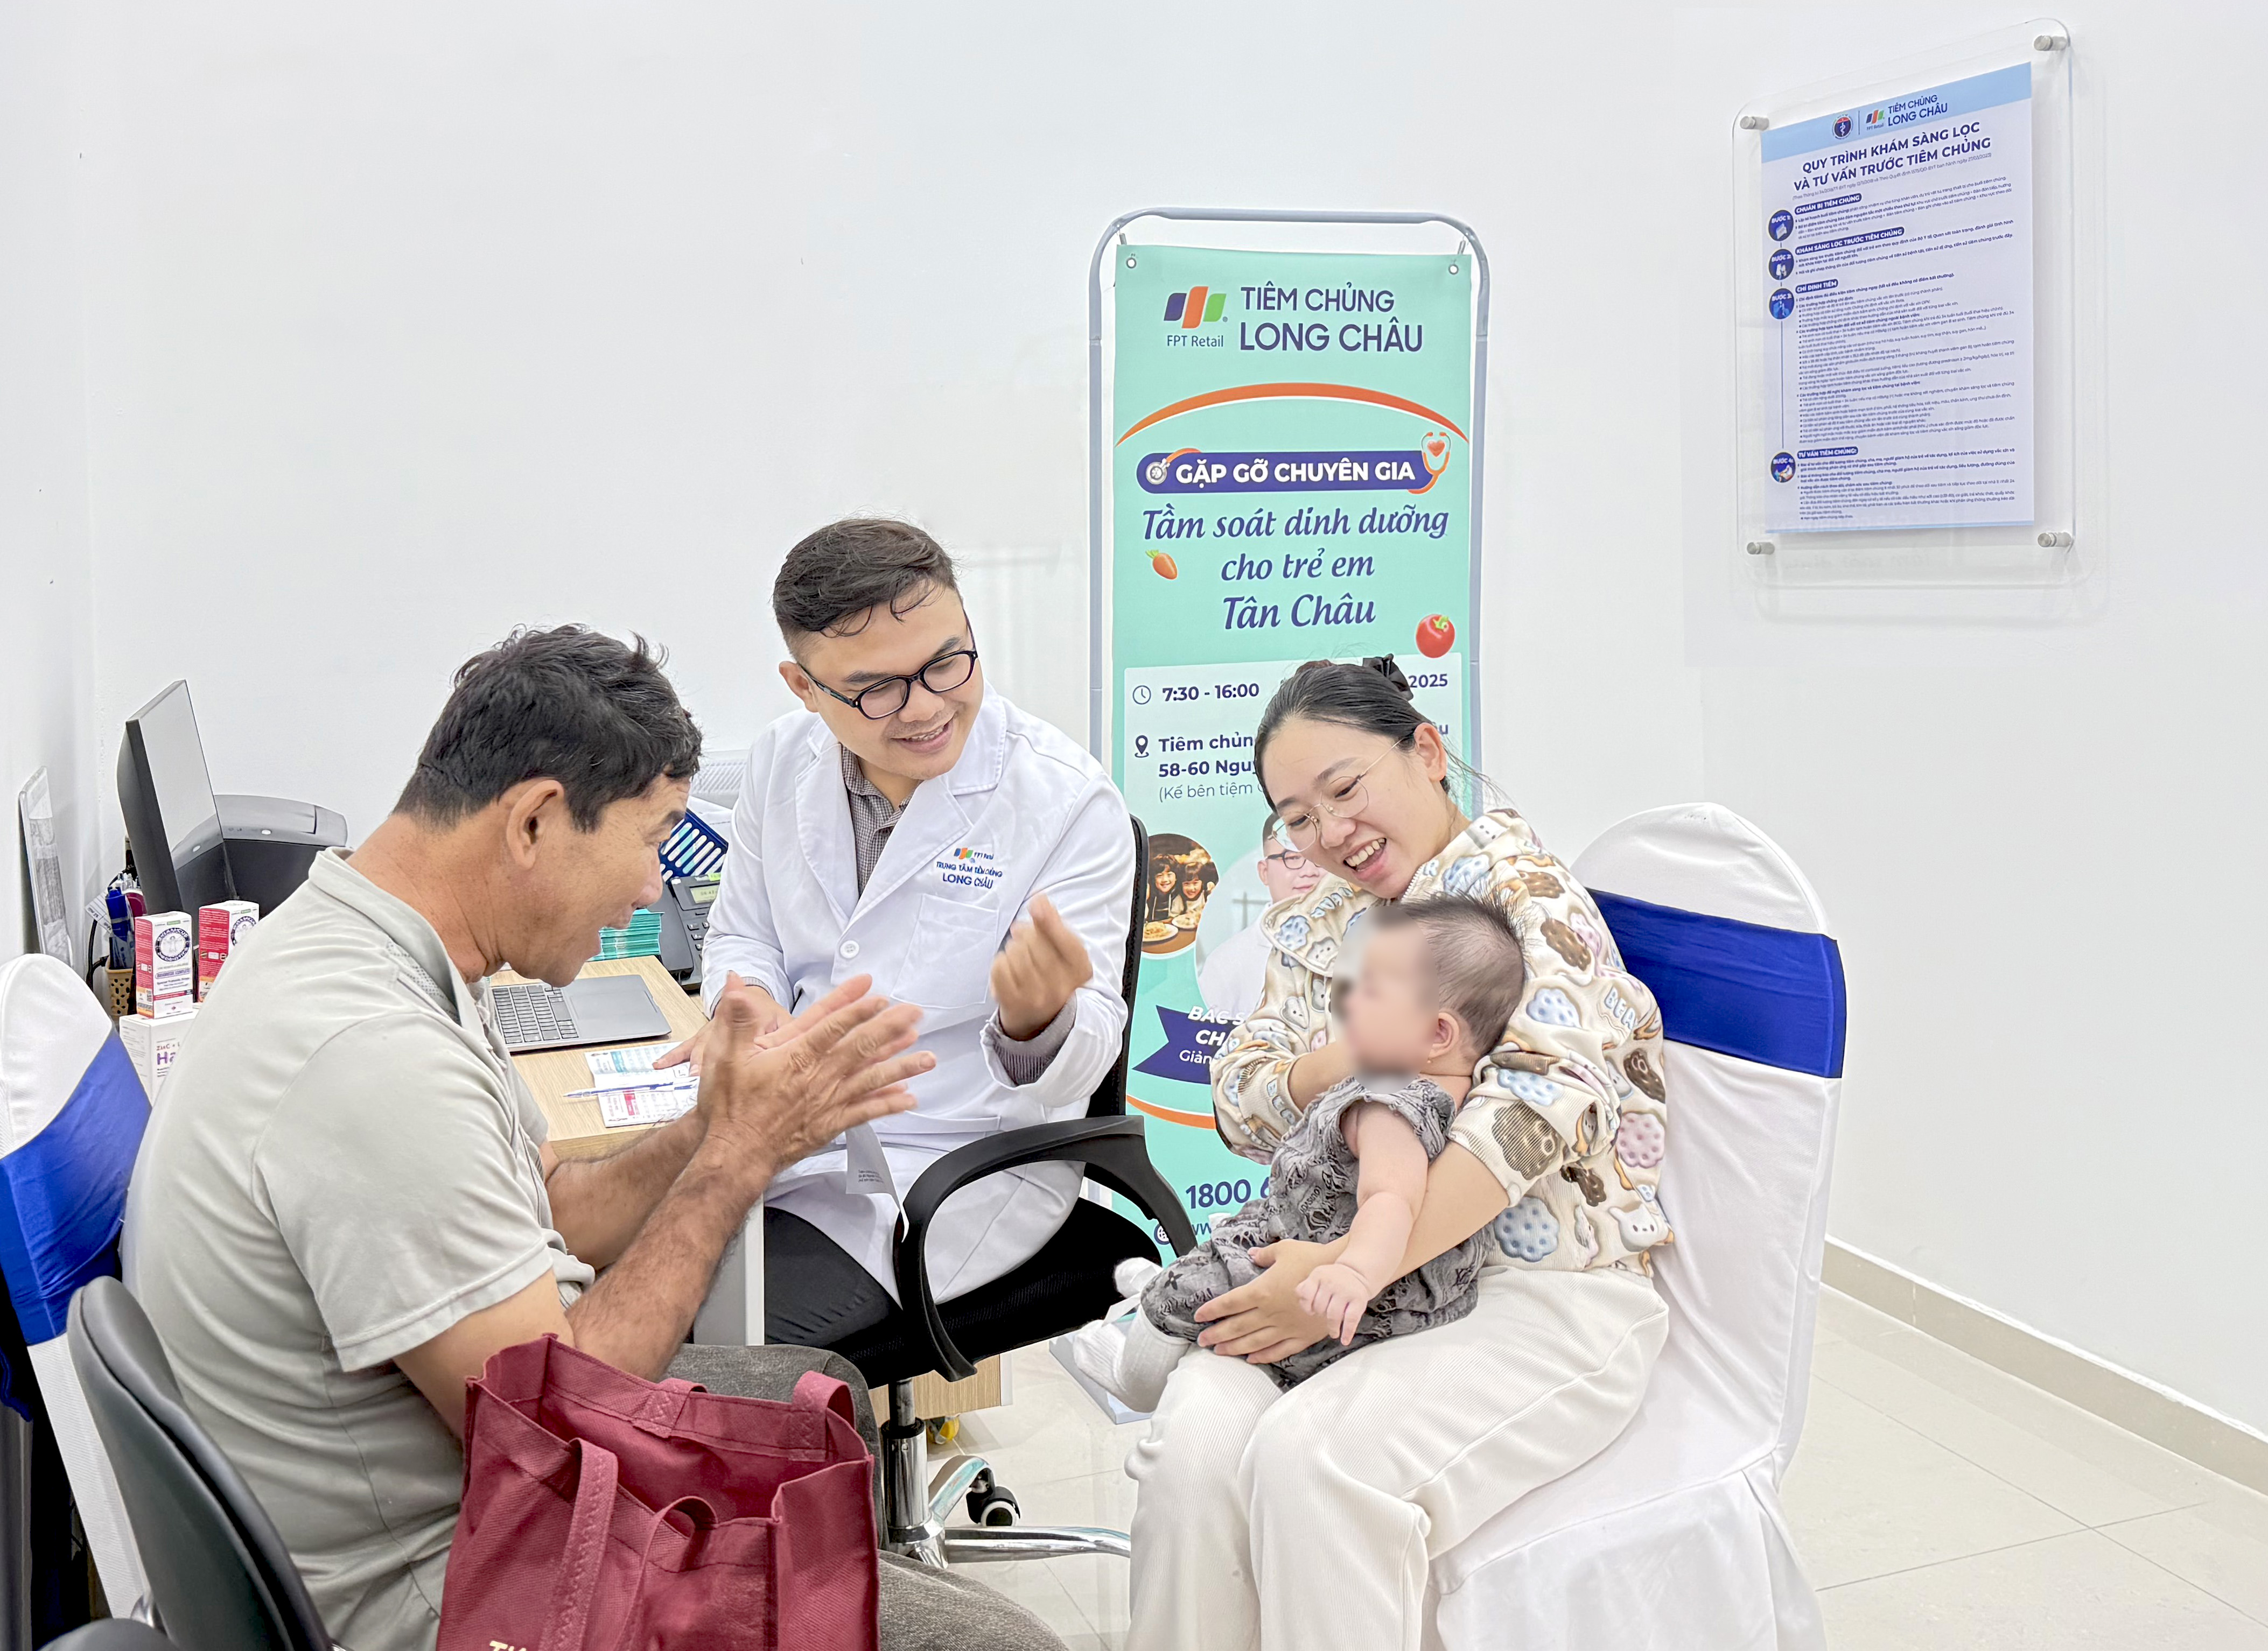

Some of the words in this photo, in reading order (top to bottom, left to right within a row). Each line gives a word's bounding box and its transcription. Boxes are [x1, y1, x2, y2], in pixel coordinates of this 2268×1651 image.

[1888, 102, 1906, 114] TIÊM
[1907, 94, 1937, 108] CHỦNG
[1888, 111, 1916, 126] LONG
[1919, 102, 1947, 118] CHÂU
[1802, 158, 1827, 173] QUY
[1830, 149, 1867, 165] TRÌNH
[1871, 138, 1908, 156] KHÁM
[1912, 129, 1948, 146] SÀNG
[1952, 122, 1979, 137] LỌC
[1794, 177, 1810, 191] VÀ
[1812, 172, 1829, 186] TƯ
[1831, 166, 1856, 182] VẤN
[1860, 157, 1903, 175] TRƯỚC
[1906, 149, 1937, 165] TIÊM
[1942, 137, 1990, 157] CHỦNG
[1241, 281, 1298, 311] TIÊM
[1305, 282, 1395, 313] CHỦNG
[1167, 335, 1187, 347] FPT
[1191, 334, 1224, 347] Retail
[1240, 322, 1330, 352] LONG
[1339, 317, 1423, 353] CHÂU
[1175, 459, 1227, 488] GẶP
[1233, 458, 1268, 483] GỠ
[1273, 458, 1370, 482] CHUYÊN
[1375, 461, 1416, 480] GIA
[1142, 503, 1204, 540] Tầm
[1213, 507, 1275, 538] soát
[1284, 507, 1351, 536] dinh
[1359, 504, 1450, 539] dưỡng
[1221, 553, 1273, 581] cho
[1282, 547, 1325, 579] trẻ
[1331, 555, 1375, 577] em
[1223, 595, 1281, 630] Tân
[1291, 592, 1377, 627] Châu
[1162, 686, 1199, 702] 7:30
[1214, 683, 1259, 699] 16:00
[1158, 736, 1203, 752] Tiêm
[1209, 732, 1253, 749] chủn
[1158, 761, 1209, 777] 58-60
[1215, 760, 1256, 776] Ngu
[1159, 784, 1183, 803] (Kế
[1187, 784, 1215, 798] bên
[1220, 782, 1253, 798] tiệm
[936, 861, 957, 870] TRUNG
[943, 873, 972, 886] LONG
[1187, 1004, 1229, 1024] BÁC
[1185, 1178, 1251, 1210] 1800
